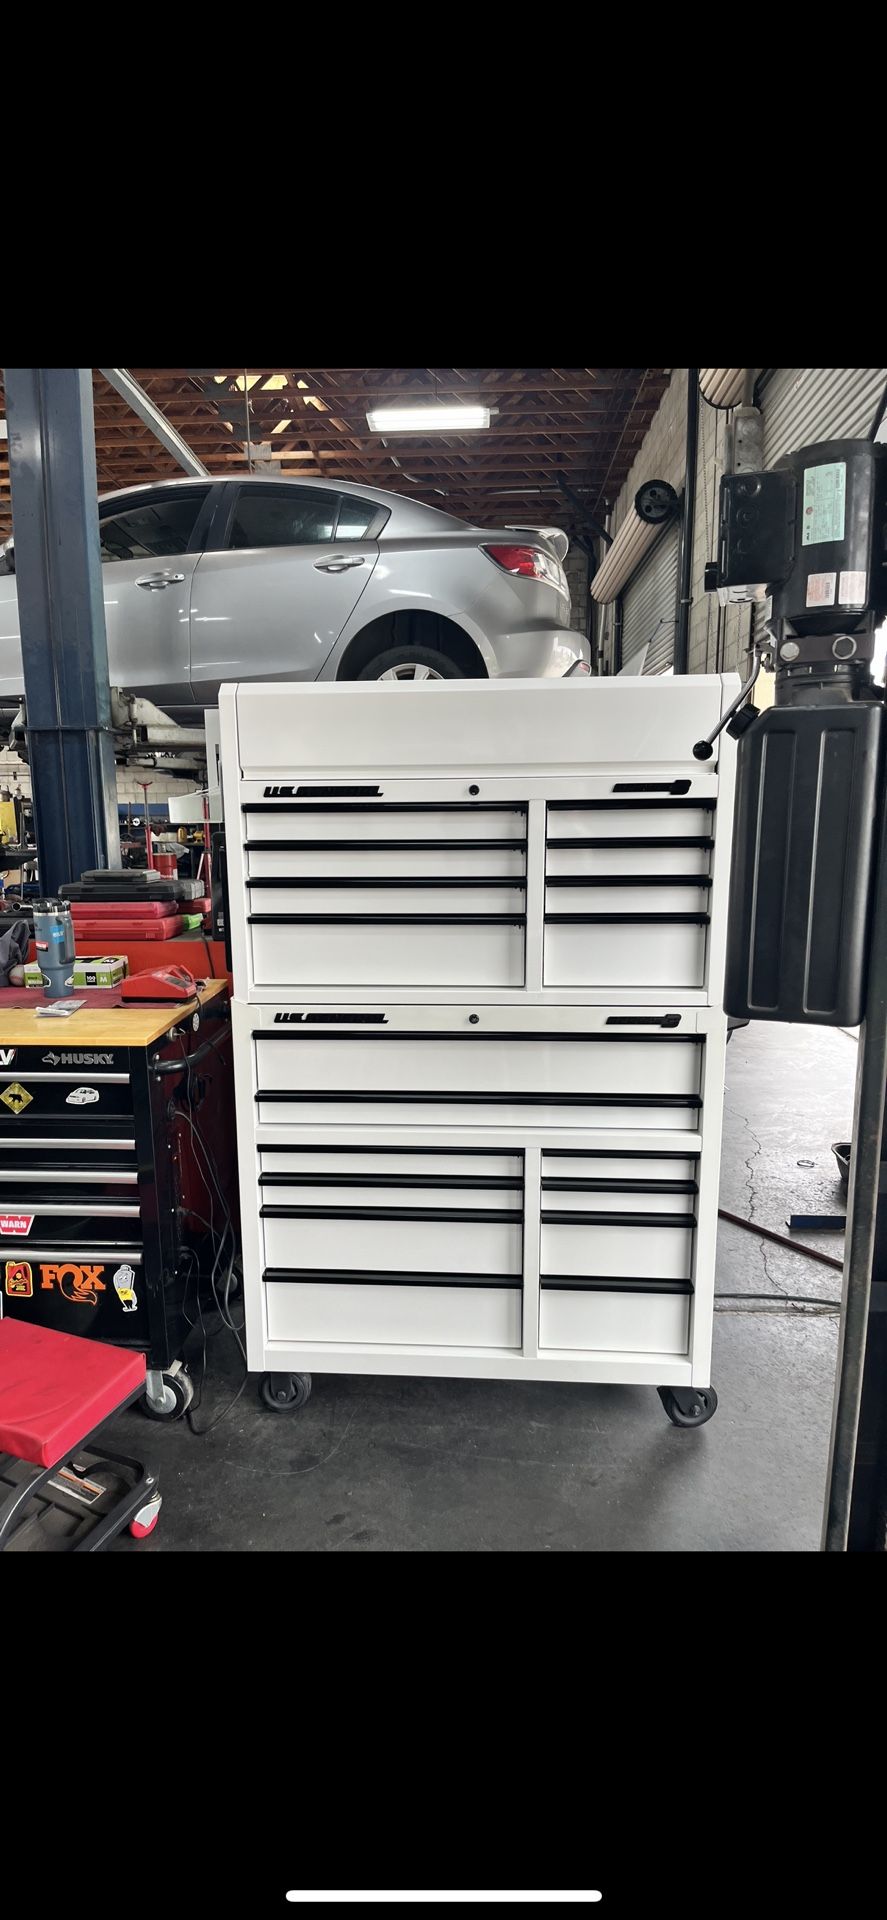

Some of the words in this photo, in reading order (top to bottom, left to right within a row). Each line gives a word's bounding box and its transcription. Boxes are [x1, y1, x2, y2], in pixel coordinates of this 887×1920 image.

[61, 1053, 114, 1065] HUSKY
[0, 1220, 27, 1229] WARN
[40, 1263, 106, 1291] FOX
